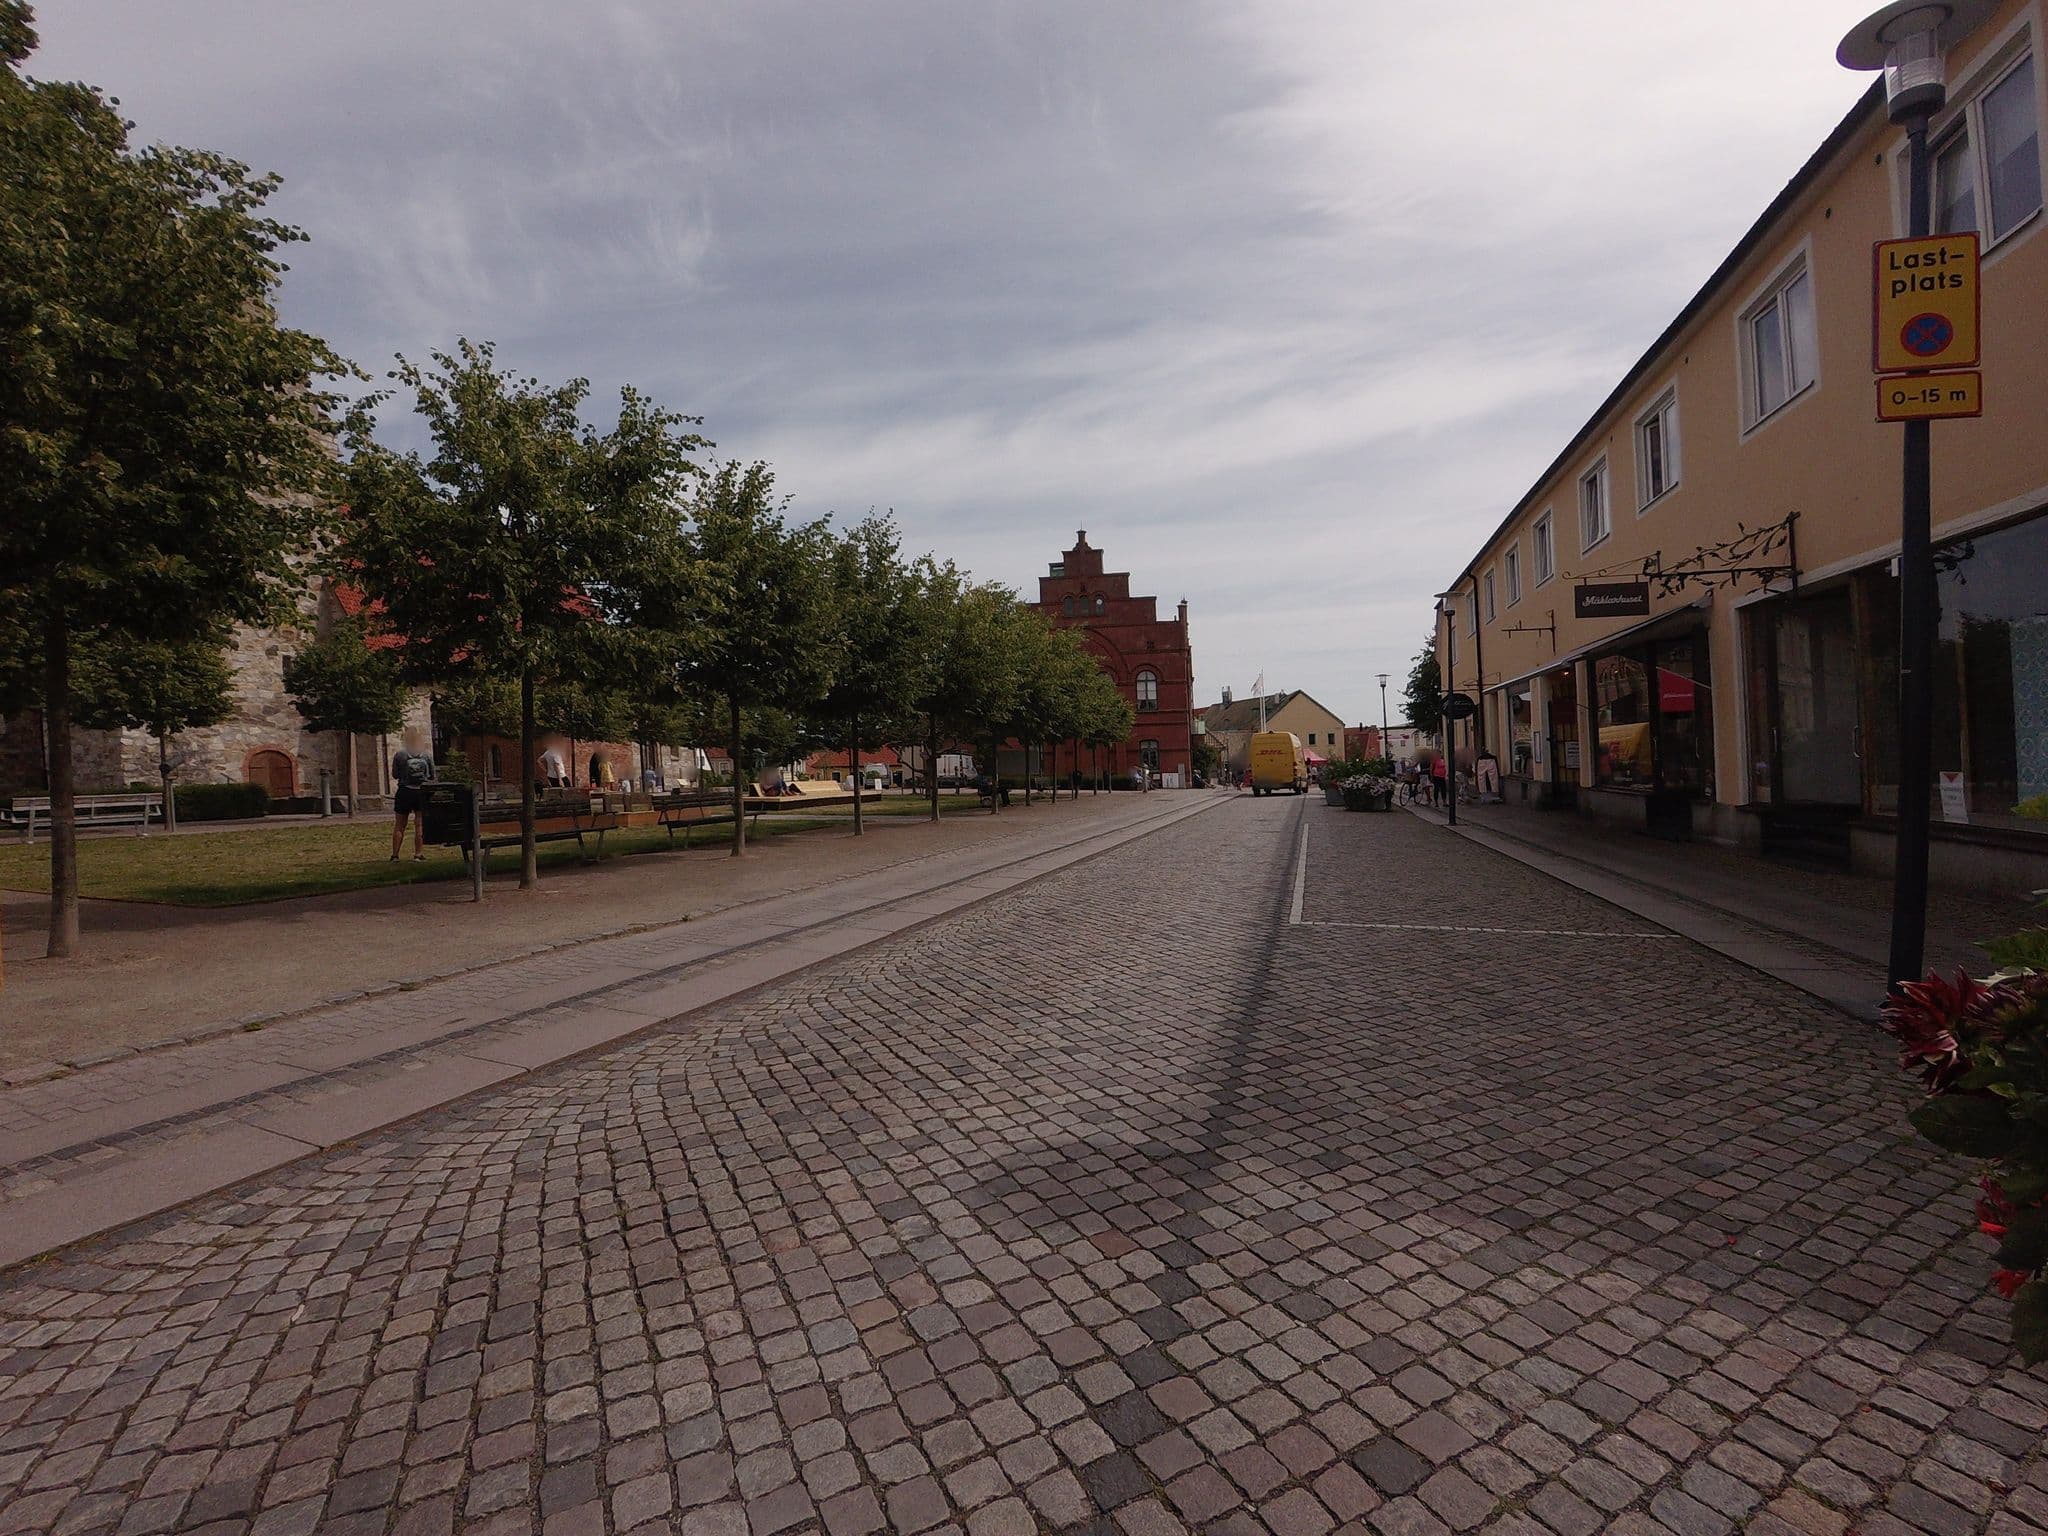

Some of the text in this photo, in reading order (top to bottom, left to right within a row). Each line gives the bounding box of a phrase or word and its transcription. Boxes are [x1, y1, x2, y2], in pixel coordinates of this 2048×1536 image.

[1889, 246, 1965, 271] Last-
[1891, 273, 1964, 299] plats
[1891, 388, 1966, 406] 0-15 m
